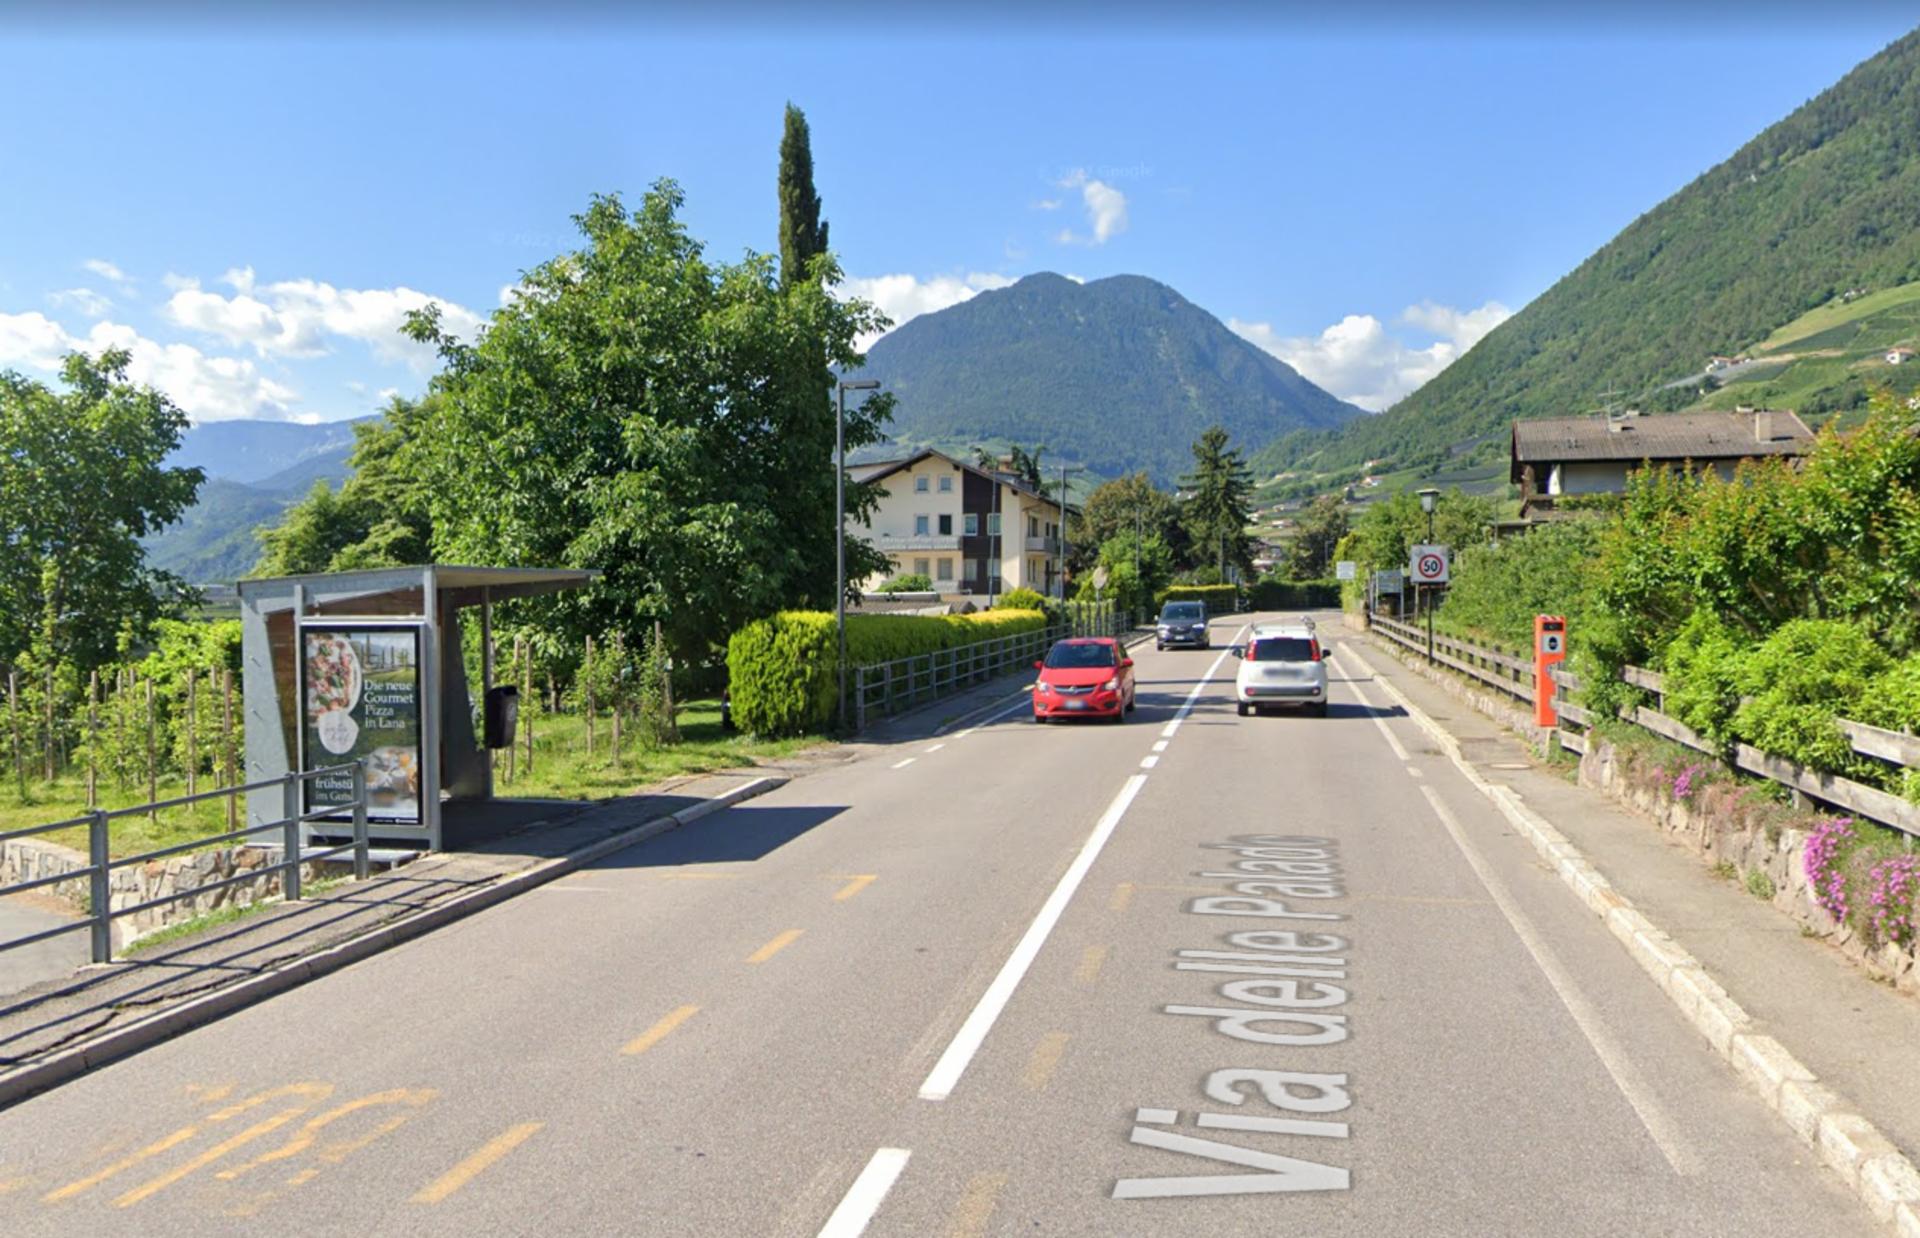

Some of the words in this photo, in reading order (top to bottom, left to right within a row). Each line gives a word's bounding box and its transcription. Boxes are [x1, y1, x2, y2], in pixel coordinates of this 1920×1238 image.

[1423, 560, 1438, 572] 50
[364, 680, 383, 690] Die
[386, 682, 413, 691] neue
[364, 692, 414, 704] Gourmet
[365, 704, 394, 716] Pizza
[379, 717, 405, 729] Lana
